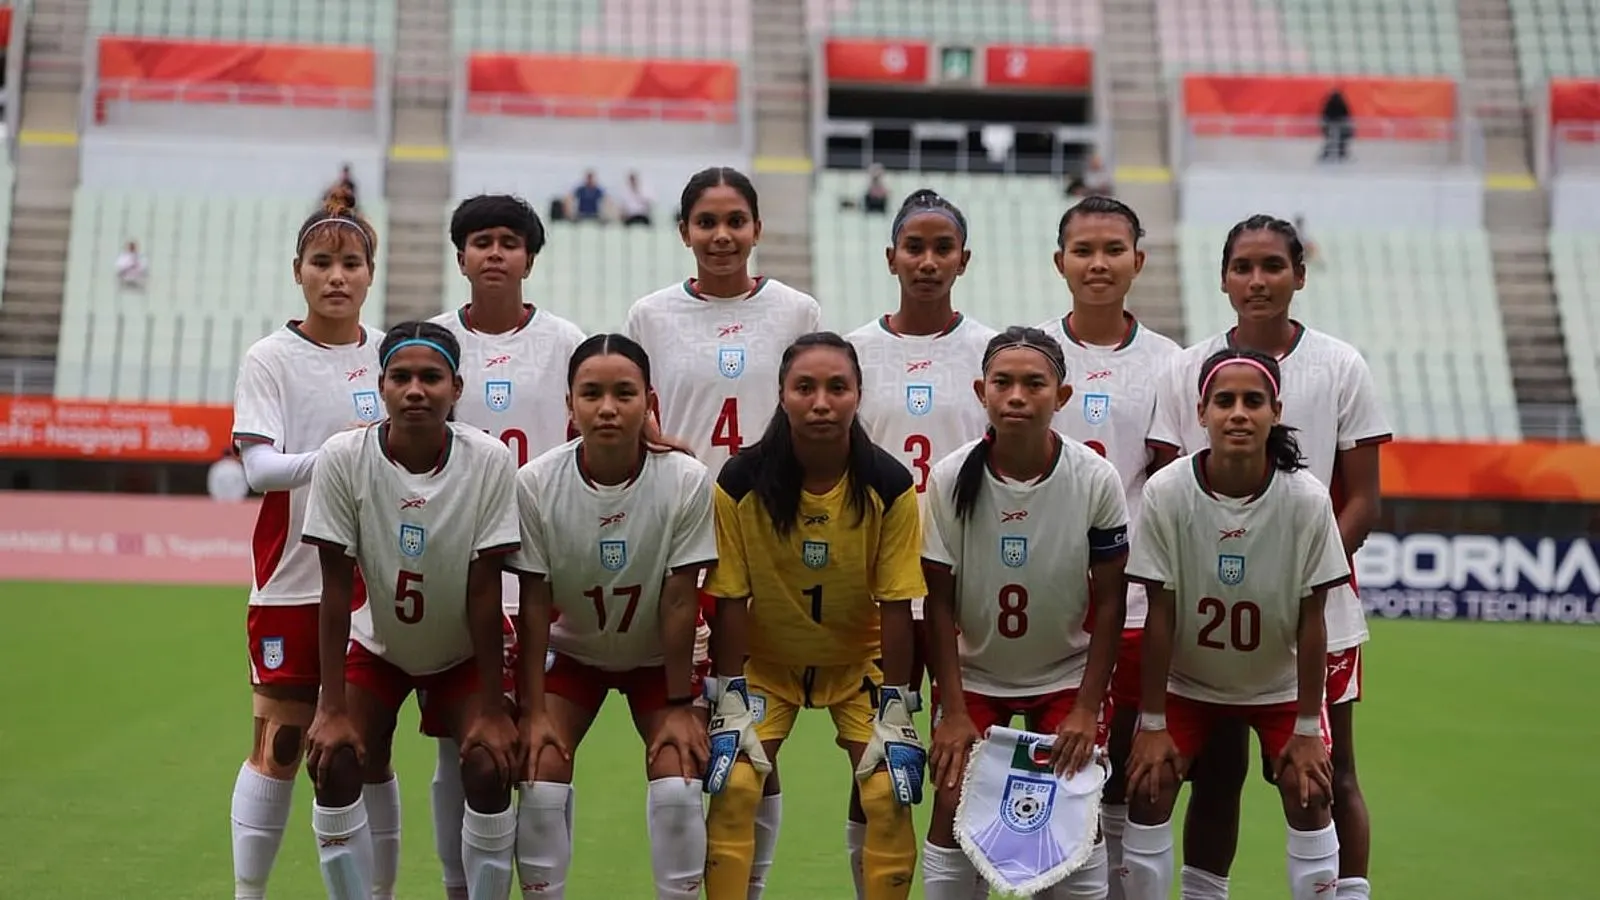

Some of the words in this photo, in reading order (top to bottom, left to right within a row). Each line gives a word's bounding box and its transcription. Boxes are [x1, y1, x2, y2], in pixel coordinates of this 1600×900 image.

[711, 398, 743, 456] 4
[904, 434, 931, 493] 3
[1353, 533, 1600, 592] BORNA
[395, 570, 424, 624] 5
[583, 584, 642, 633] 17
[802, 585, 823, 624] 1
[998, 584, 1028, 638] 8
[1197, 597, 1261, 652] 20
[712, 754, 731, 790] ONE
[893, 766, 910, 801] ONE
